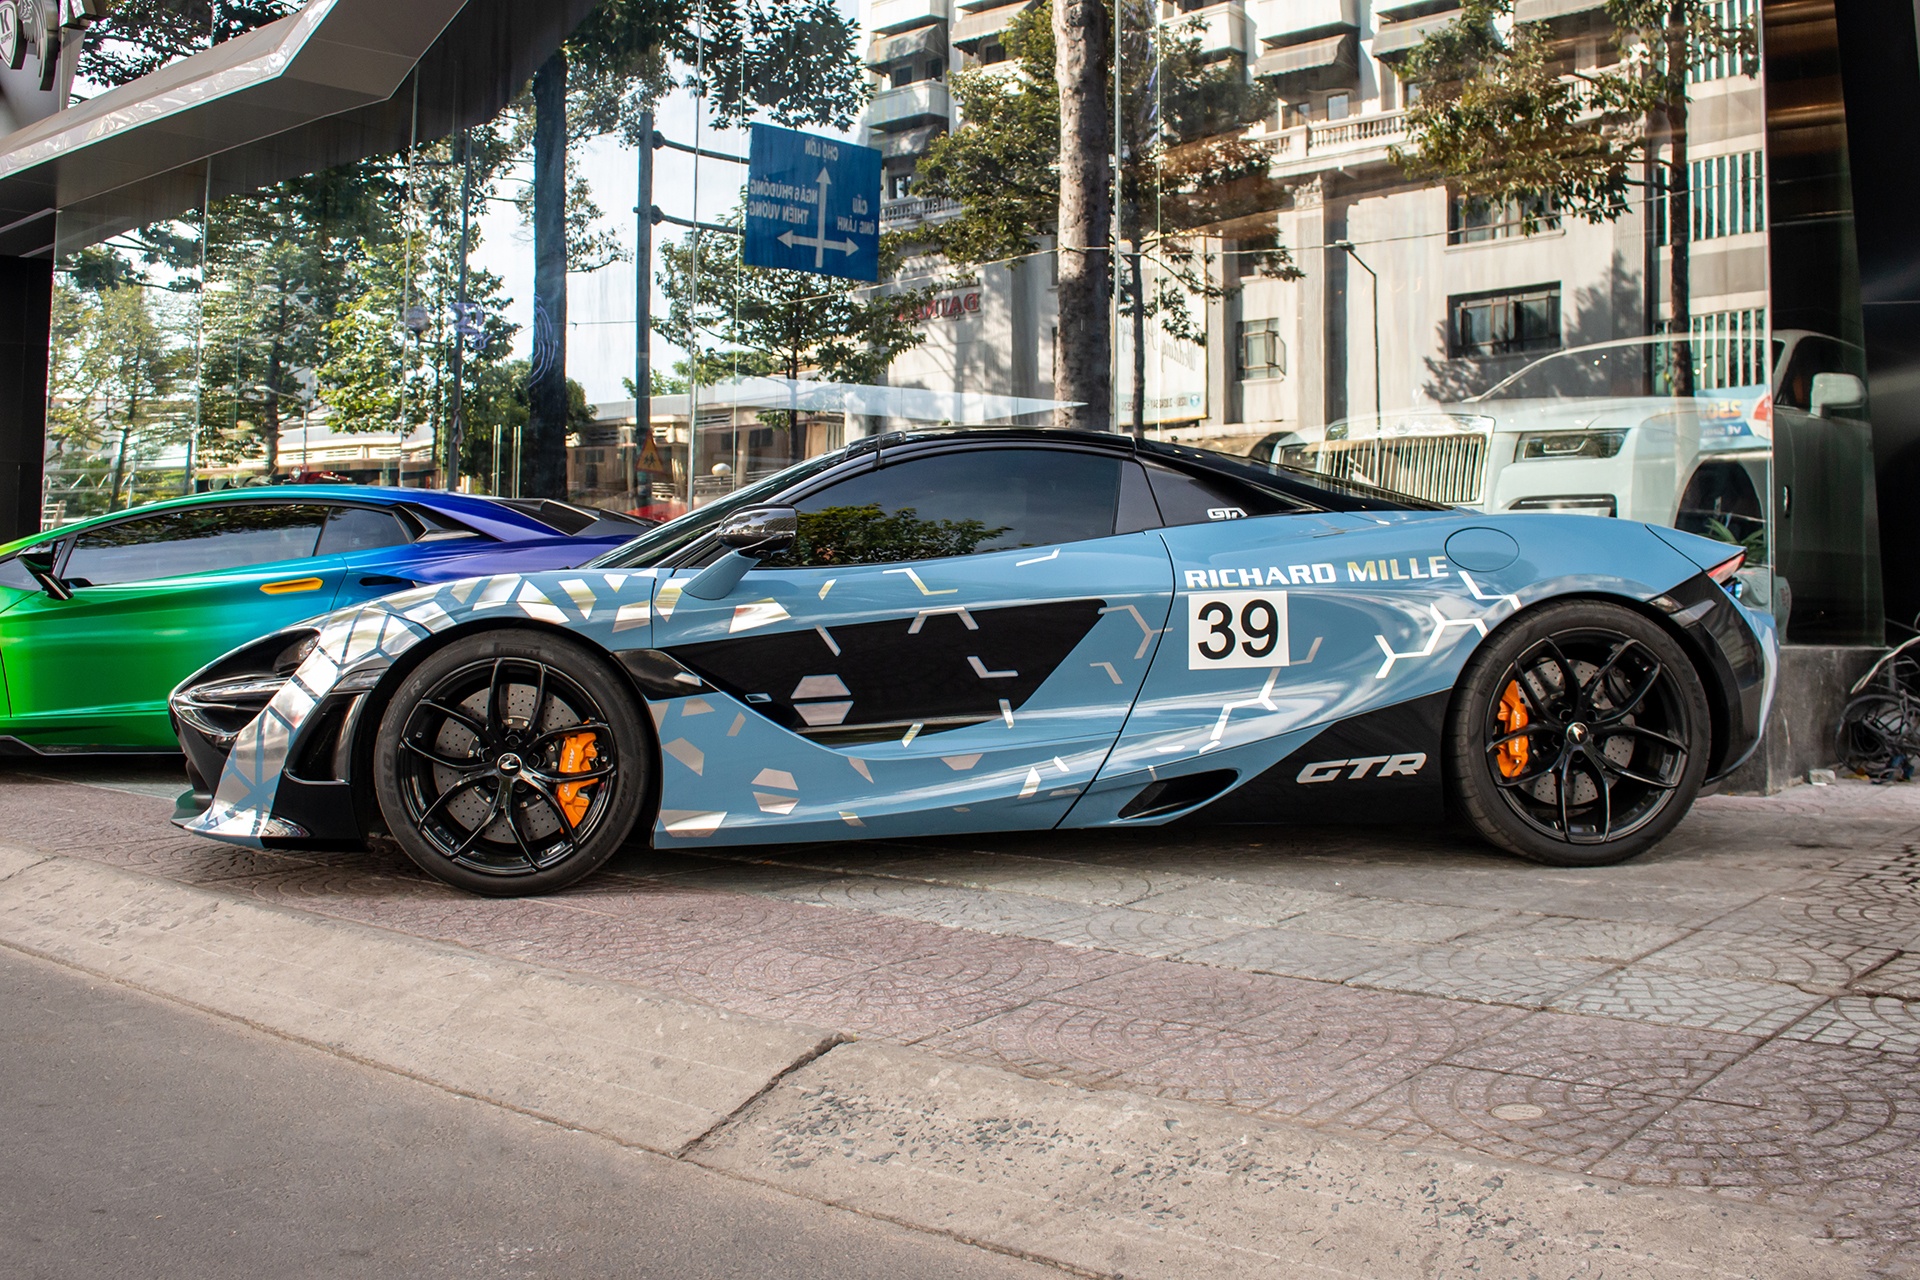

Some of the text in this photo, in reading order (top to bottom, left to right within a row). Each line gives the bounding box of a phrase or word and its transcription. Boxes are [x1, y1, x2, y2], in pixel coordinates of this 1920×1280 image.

[1184, 555, 1449, 589] RICHARD MILLE
[1197, 598, 1280, 660] 39
[1295, 751, 1427, 785] GTR
